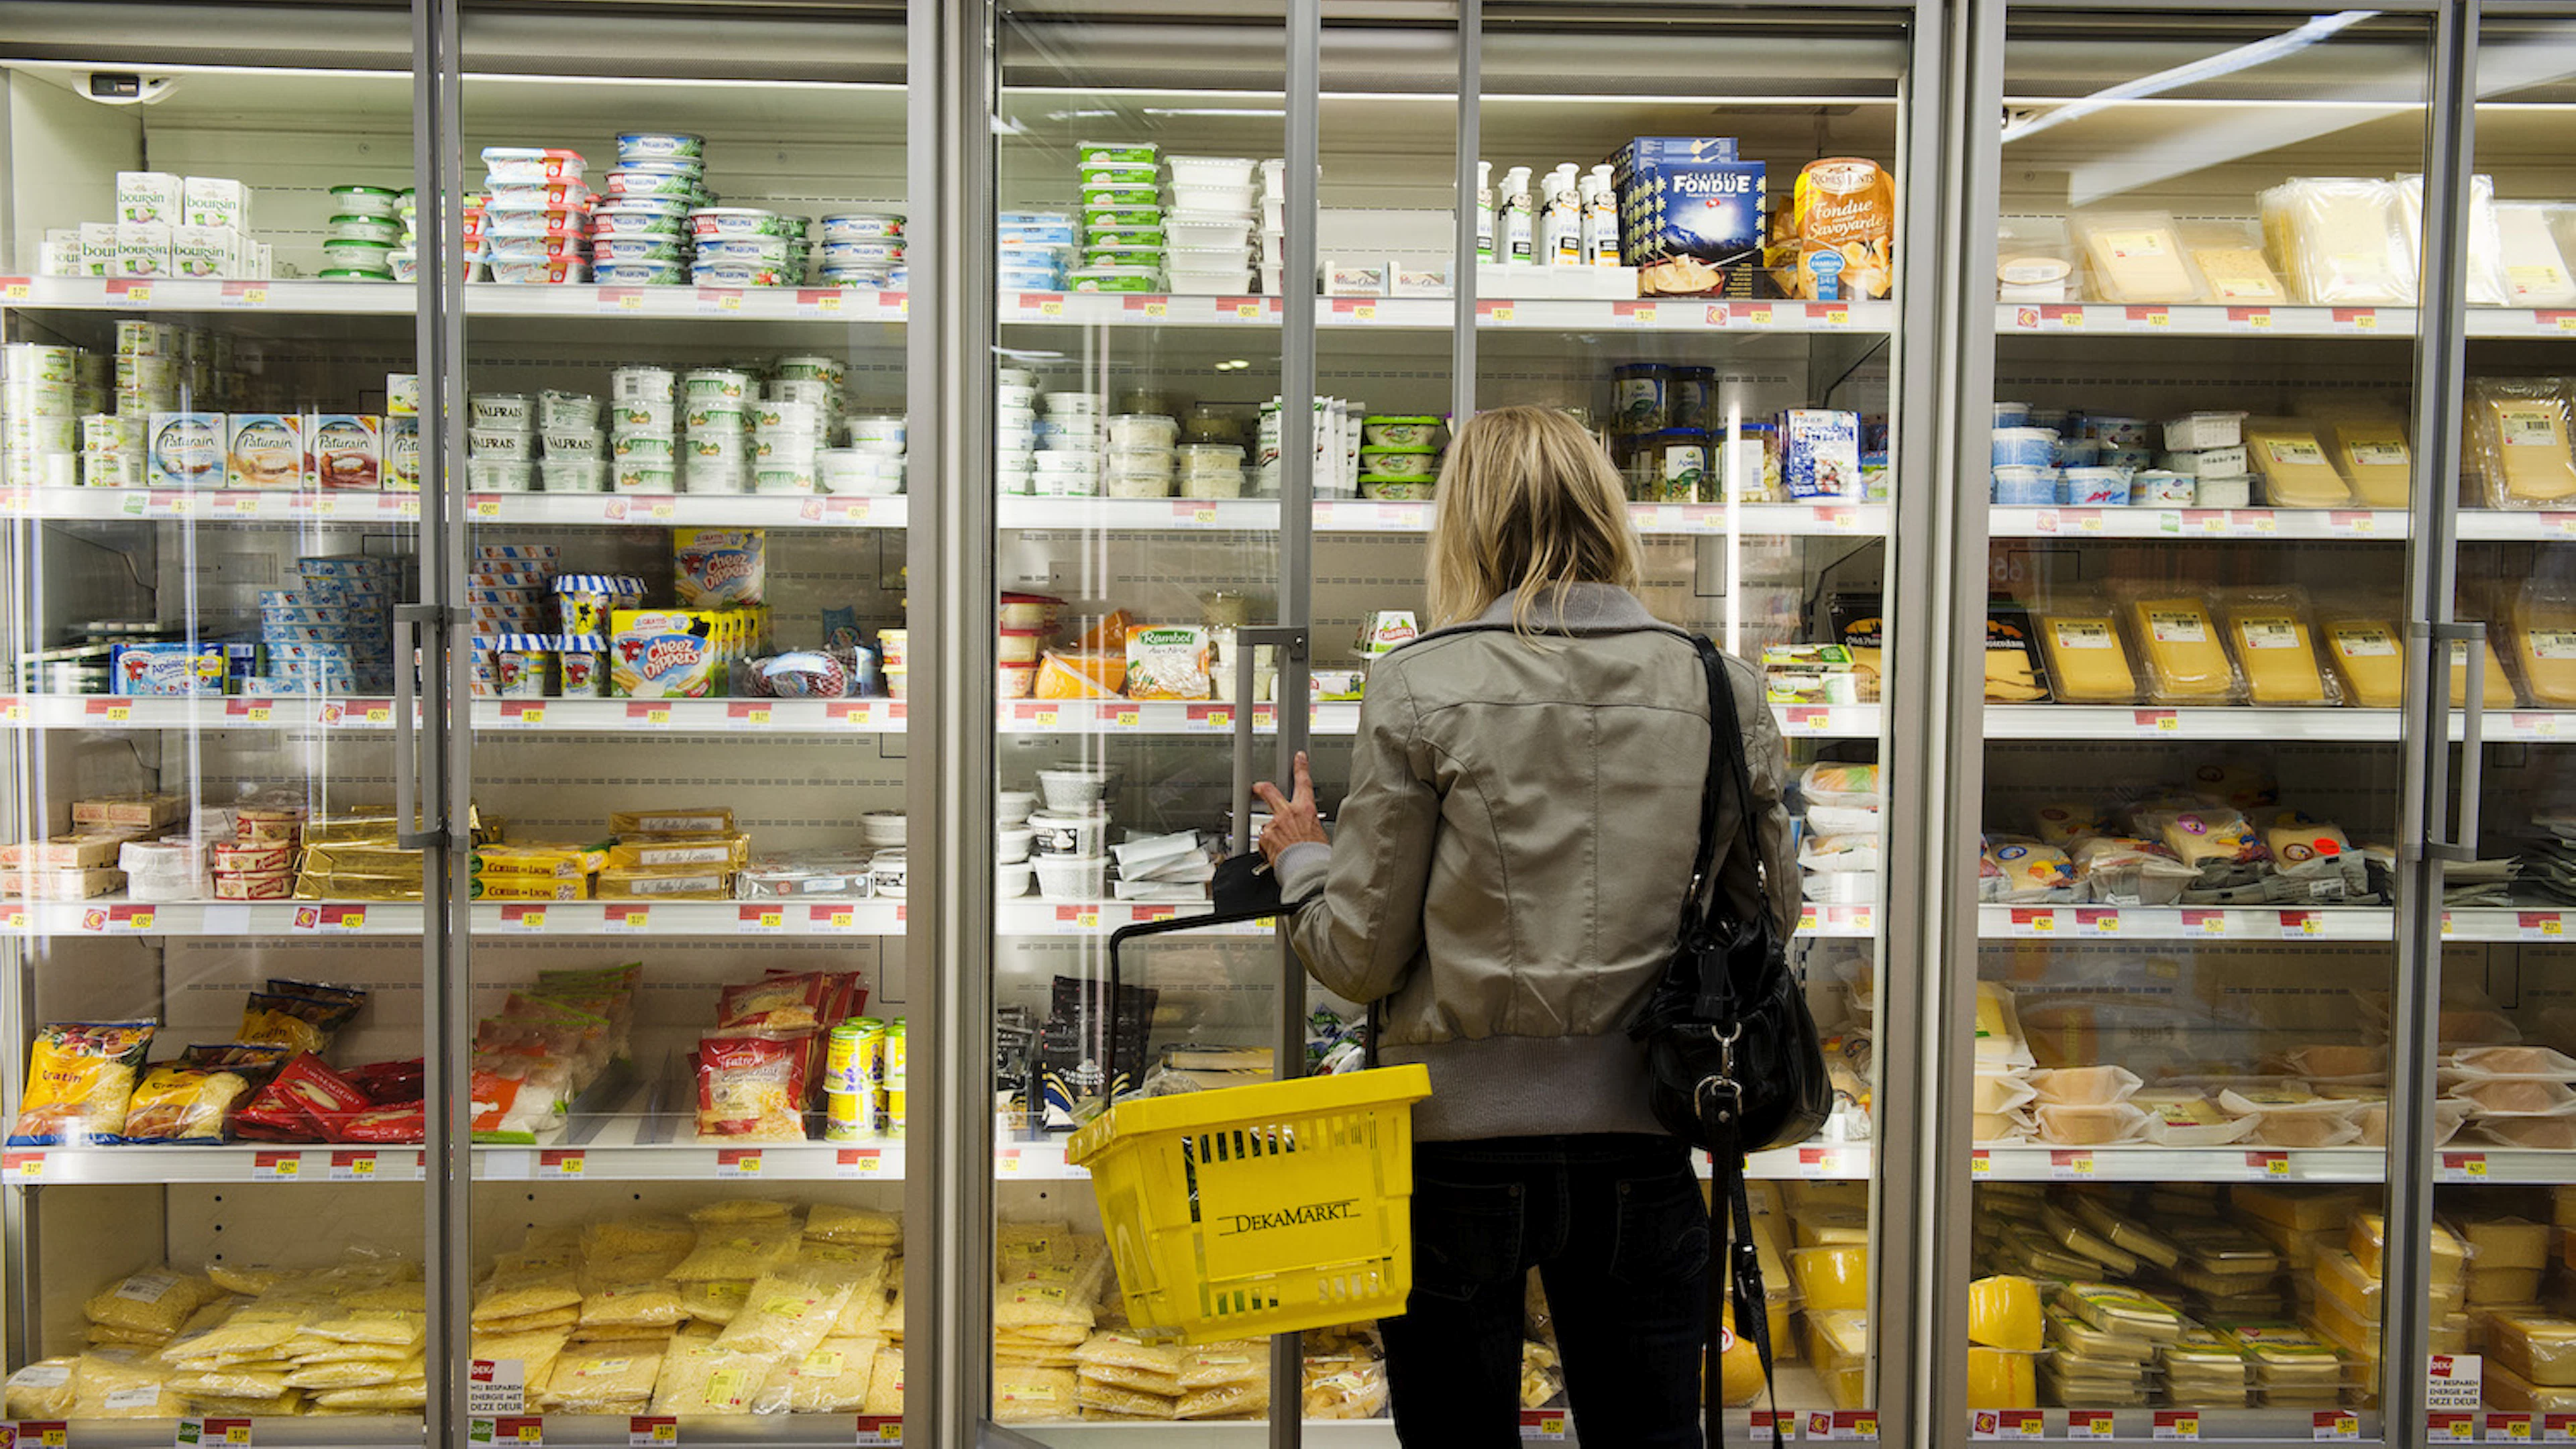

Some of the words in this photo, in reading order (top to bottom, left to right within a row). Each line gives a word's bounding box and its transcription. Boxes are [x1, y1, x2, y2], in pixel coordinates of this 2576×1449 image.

[1673, 175, 1752, 193] FONDUE
[1688, 172, 1736, 180] CLASSIC
[119, 191, 165, 205] boursin
[186, 197, 237, 212] boursin
[1813, 200, 1874, 220] Fondue
[1808, 213, 1884, 240] Savoyarde
[83, 242, 116, 258] bour
[117, 240, 168, 258] boursin
[174, 242, 225, 260] boursin
[241, 433, 292, 449] Paturain
[319, 433, 369, 449] Paturain
[706, 553, 749, 575] Cheez
[703, 563, 754, 591] Dippers
[1142, 631, 1192, 644] Rambol
[645, 637, 695, 663] Cheez
[643, 649, 700, 680] Dippers
[529, 865, 552, 875] LION
[529, 886, 552, 898] LION
[42, 1069, 82, 1085] Gratin
[471, 1393, 504, 1401] ENERGIE
[507, 1393, 523, 1401] MET
[2429, 1397, 2452, 1405] DEZE
[2454, 1397, 2478, 1405] DEUR
[470, 1401, 494, 1411] DEZE
[498, 1401, 523, 1411] DEUR
